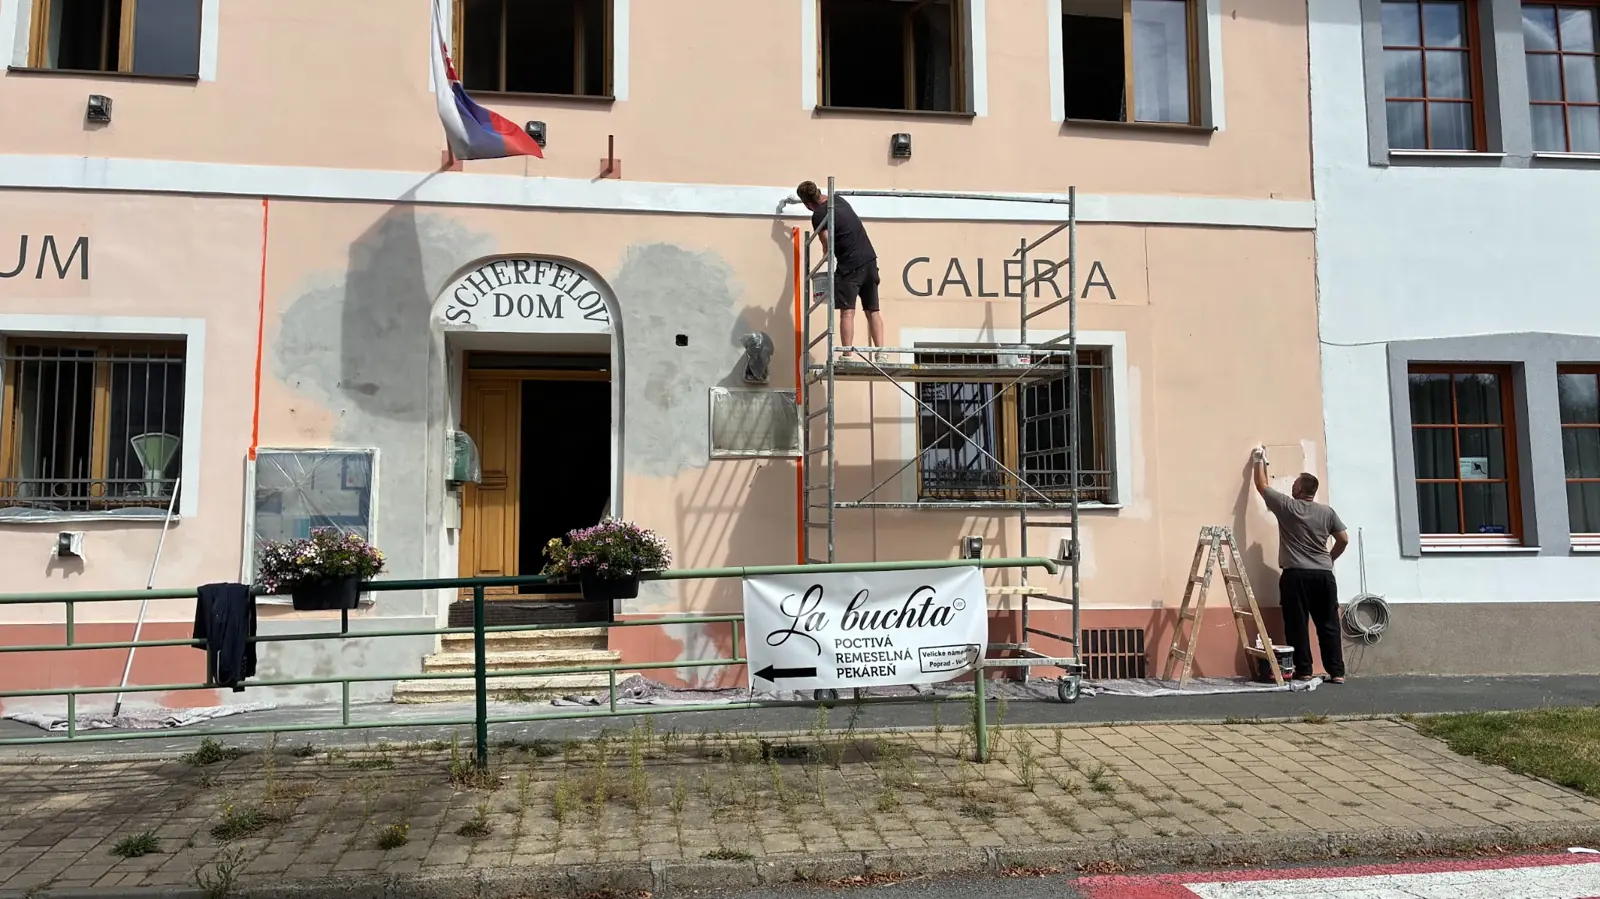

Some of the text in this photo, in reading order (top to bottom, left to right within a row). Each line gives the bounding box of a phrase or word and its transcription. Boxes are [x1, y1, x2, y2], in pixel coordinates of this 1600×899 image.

[902, 248, 1117, 300] GALÉRA
[445, 259, 610, 326] SCHERFELOV
[493, 293, 565, 319] DOM
[766, 583, 956, 656] La buchta
[834, 634, 893, 649] POCTIVÁ
[835, 647, 913, 664] REMESELNÁ
[929, 660, 951, 668] Poprad
[836, 662, 897, 679] PEKÁREŇ
